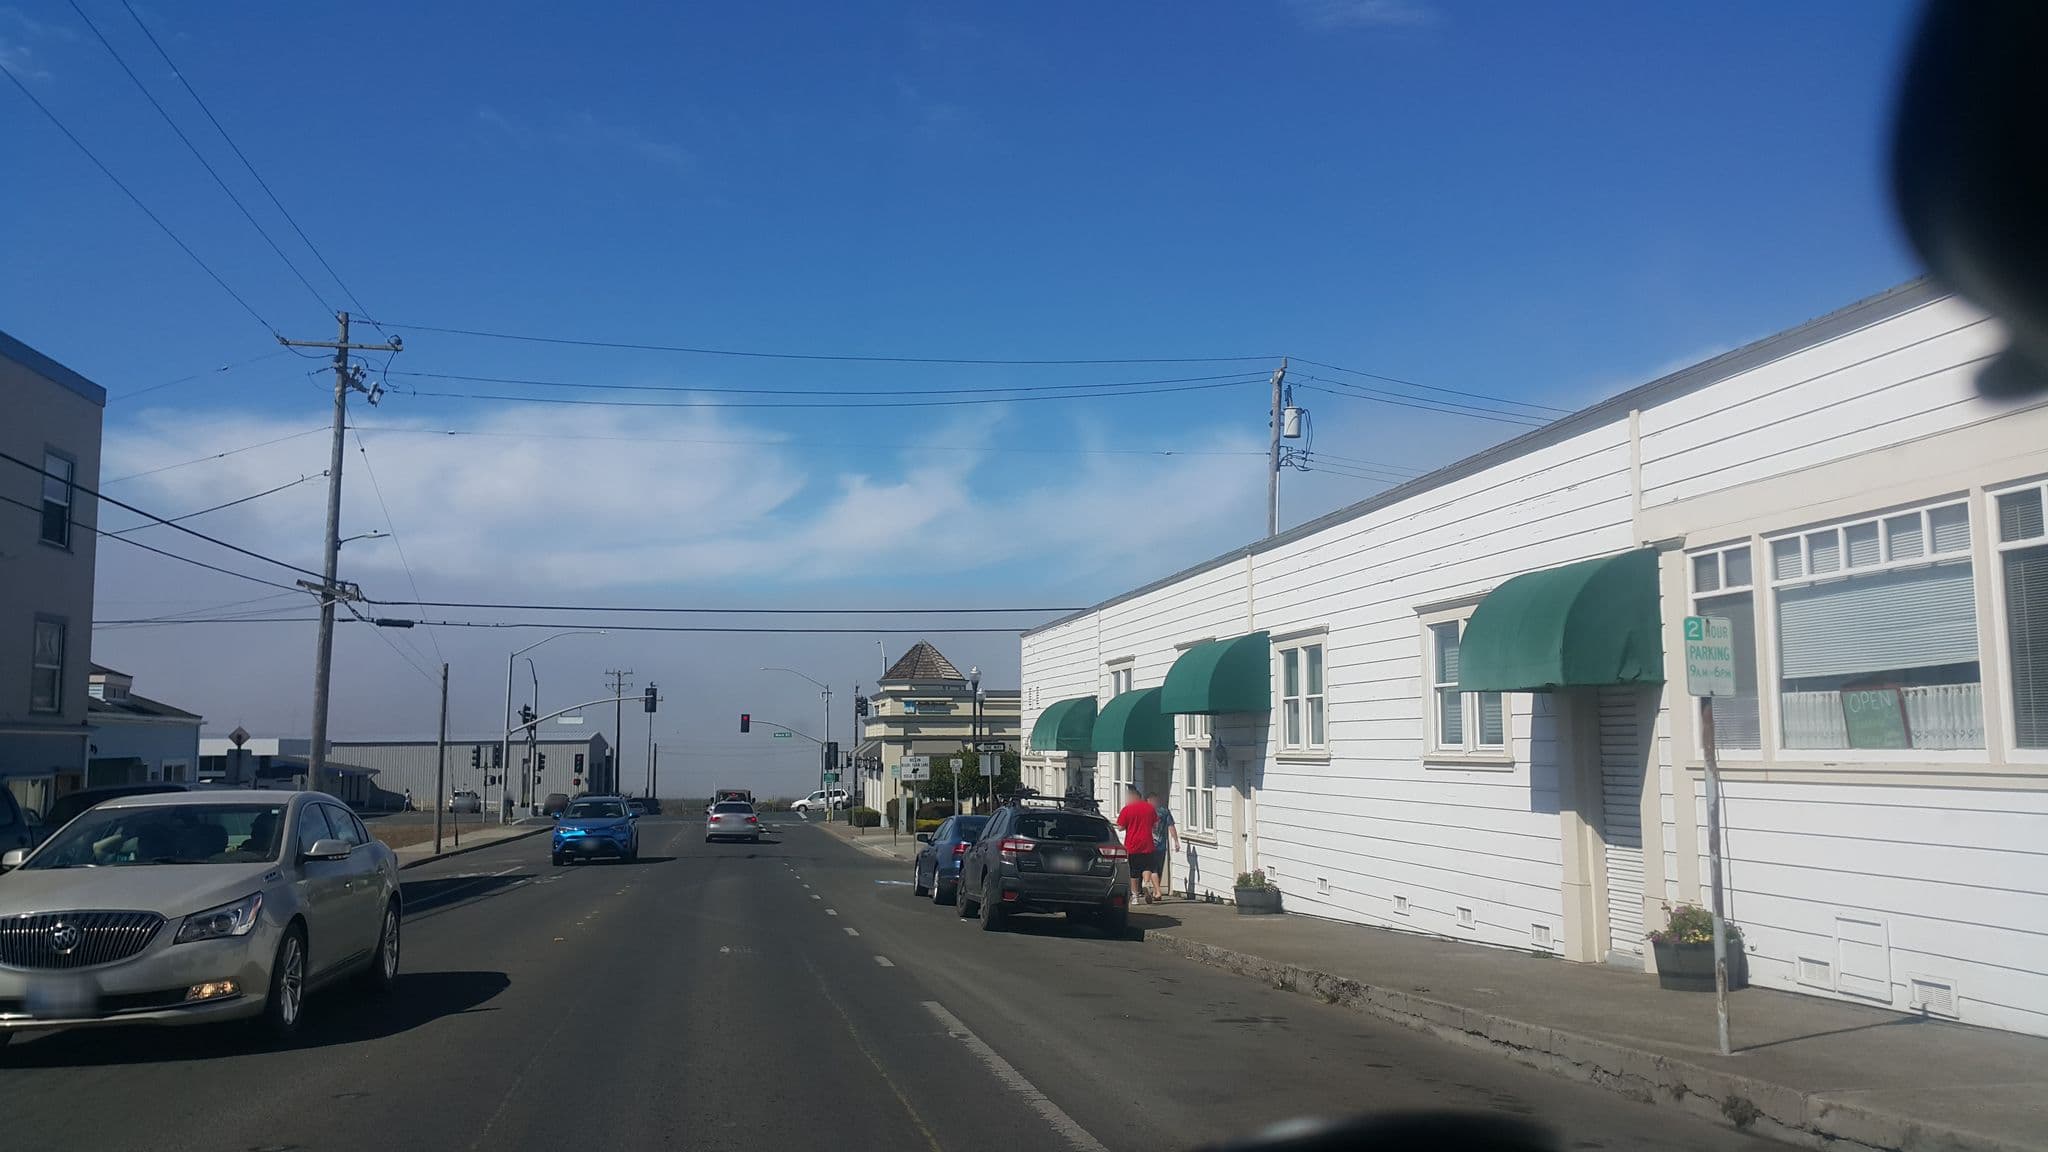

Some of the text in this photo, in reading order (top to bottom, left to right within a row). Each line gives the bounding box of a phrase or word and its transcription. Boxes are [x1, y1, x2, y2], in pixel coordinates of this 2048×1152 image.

[1687, 621, 1728, 639] 2 HOUR
[1689, 646, 1730, 661] PARKING
[1850, 690, 1891, 712] OPEN
